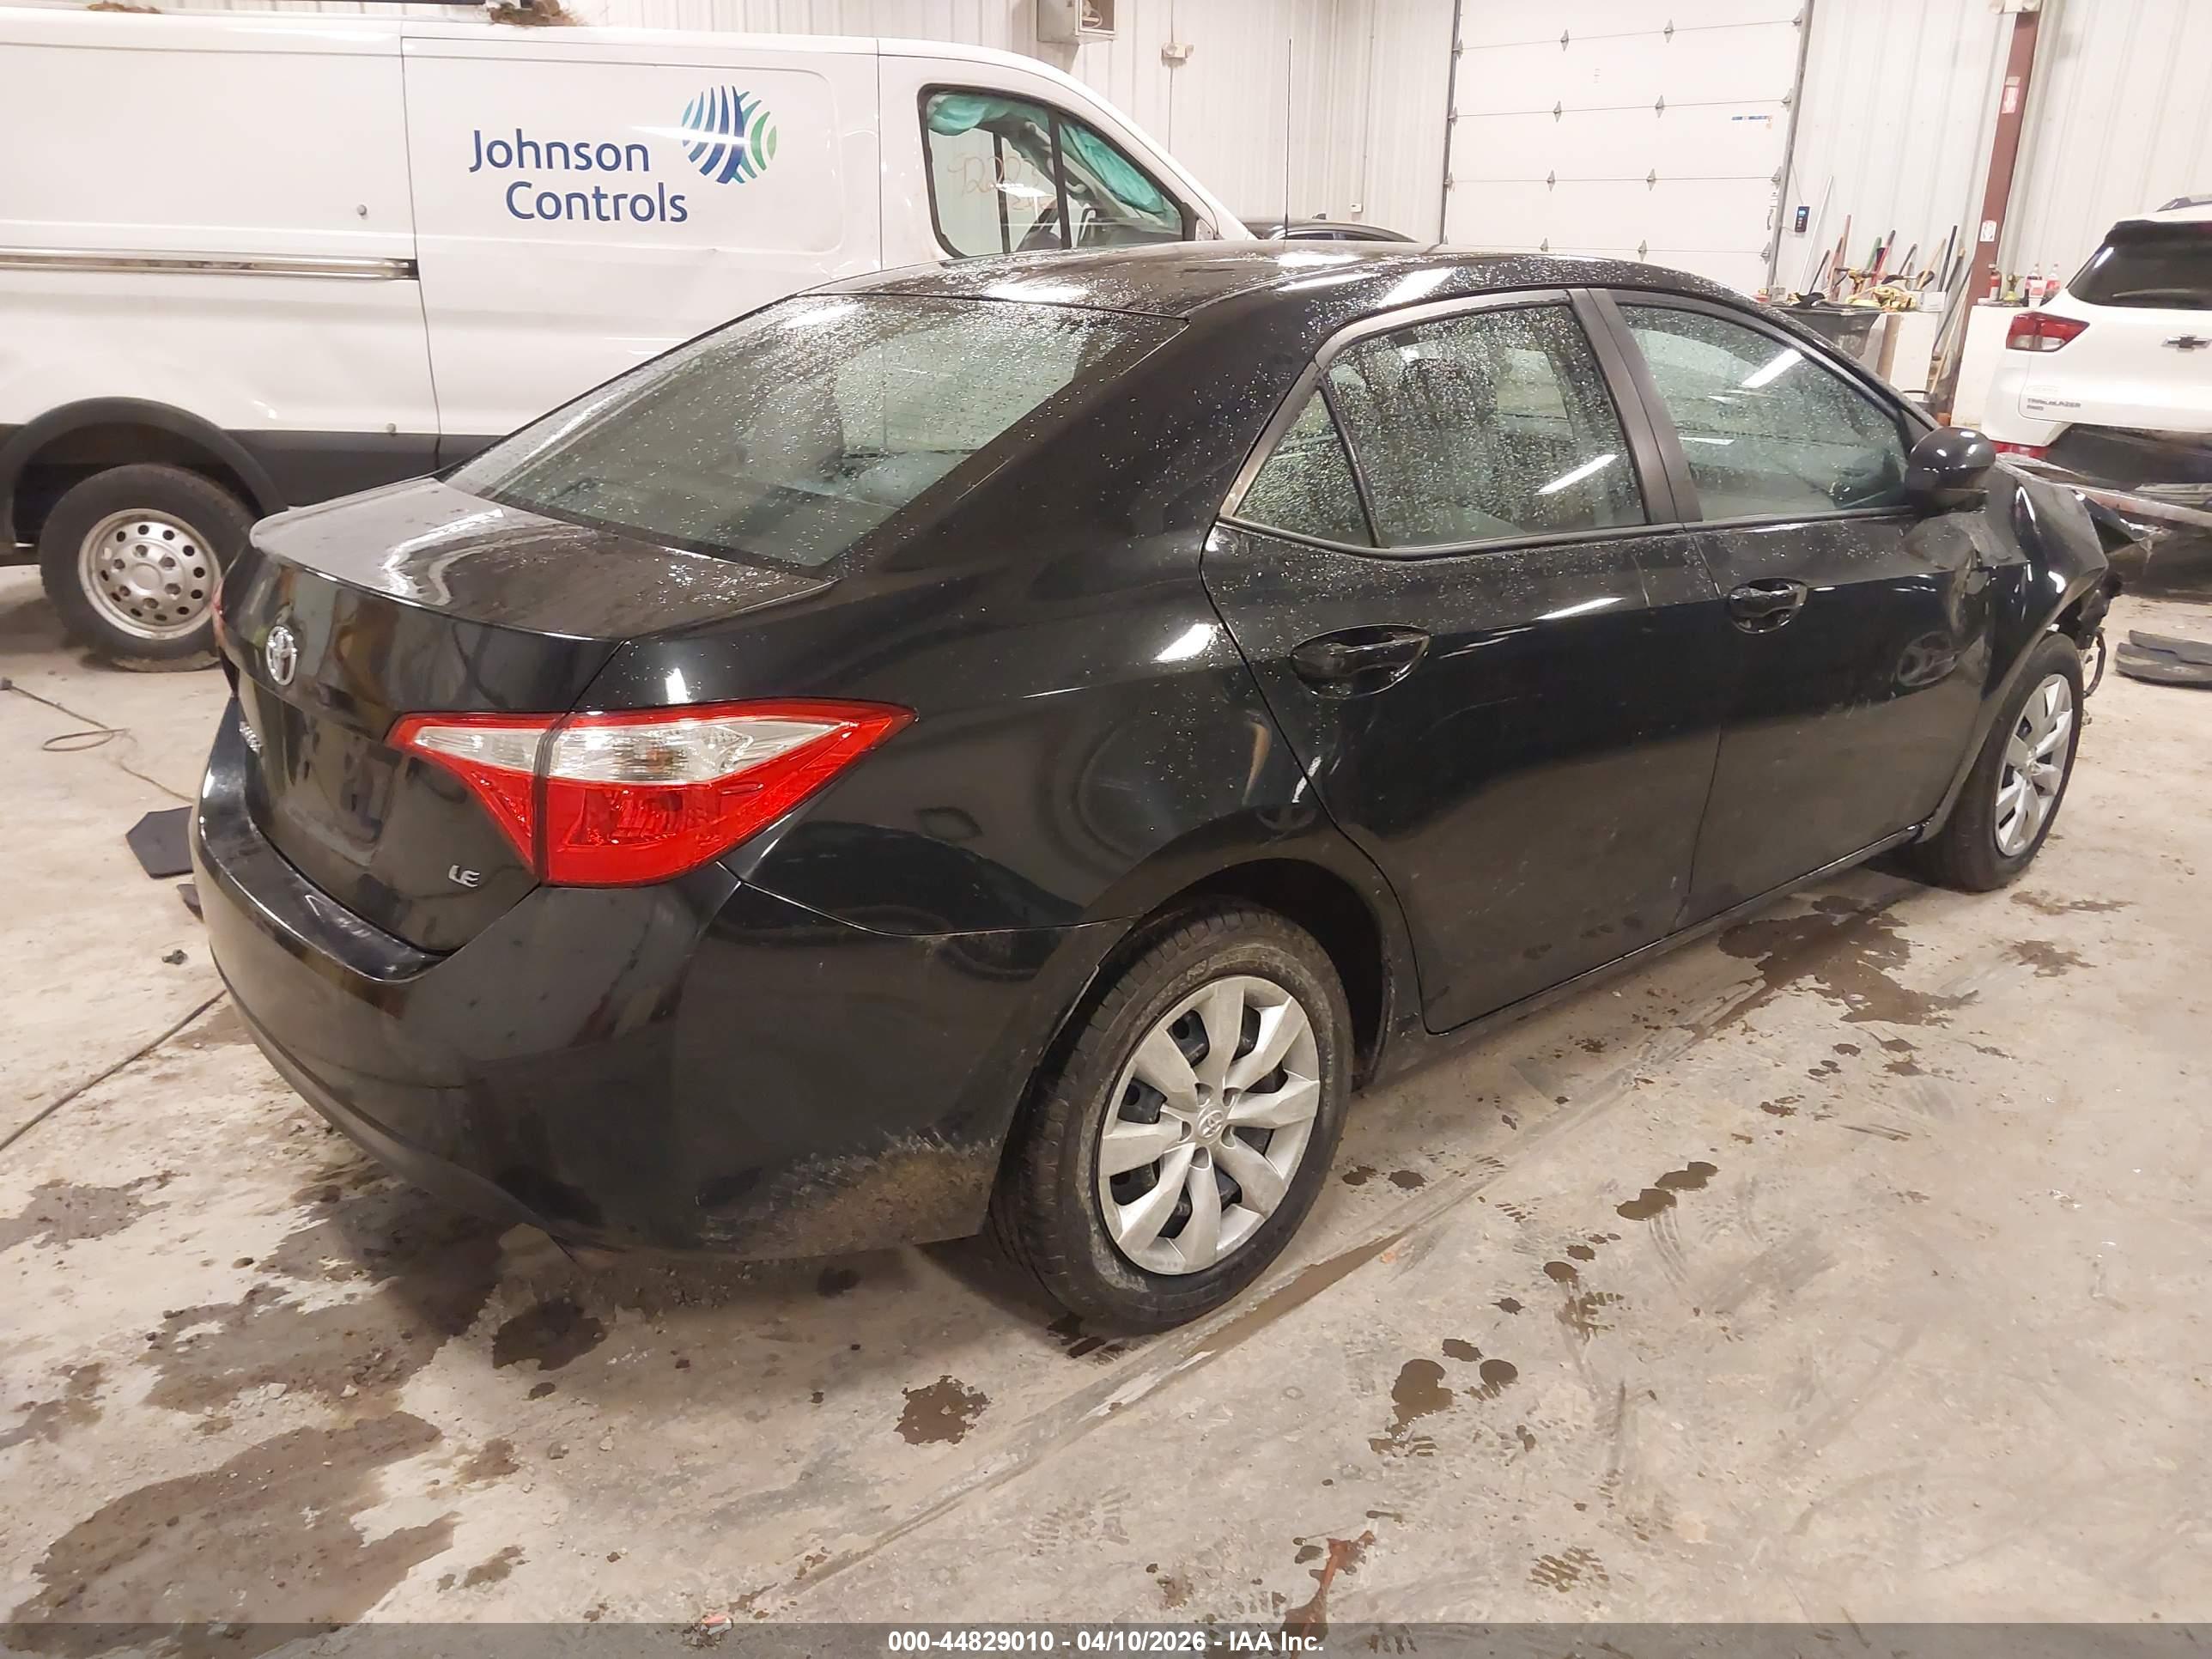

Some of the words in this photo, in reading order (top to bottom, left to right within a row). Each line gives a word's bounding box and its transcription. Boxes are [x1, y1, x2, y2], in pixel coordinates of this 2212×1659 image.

[469, 128, 649, 173] Johnson
[506, 181, 688, 222] Controls
[448, 864, 480, 888] LE
